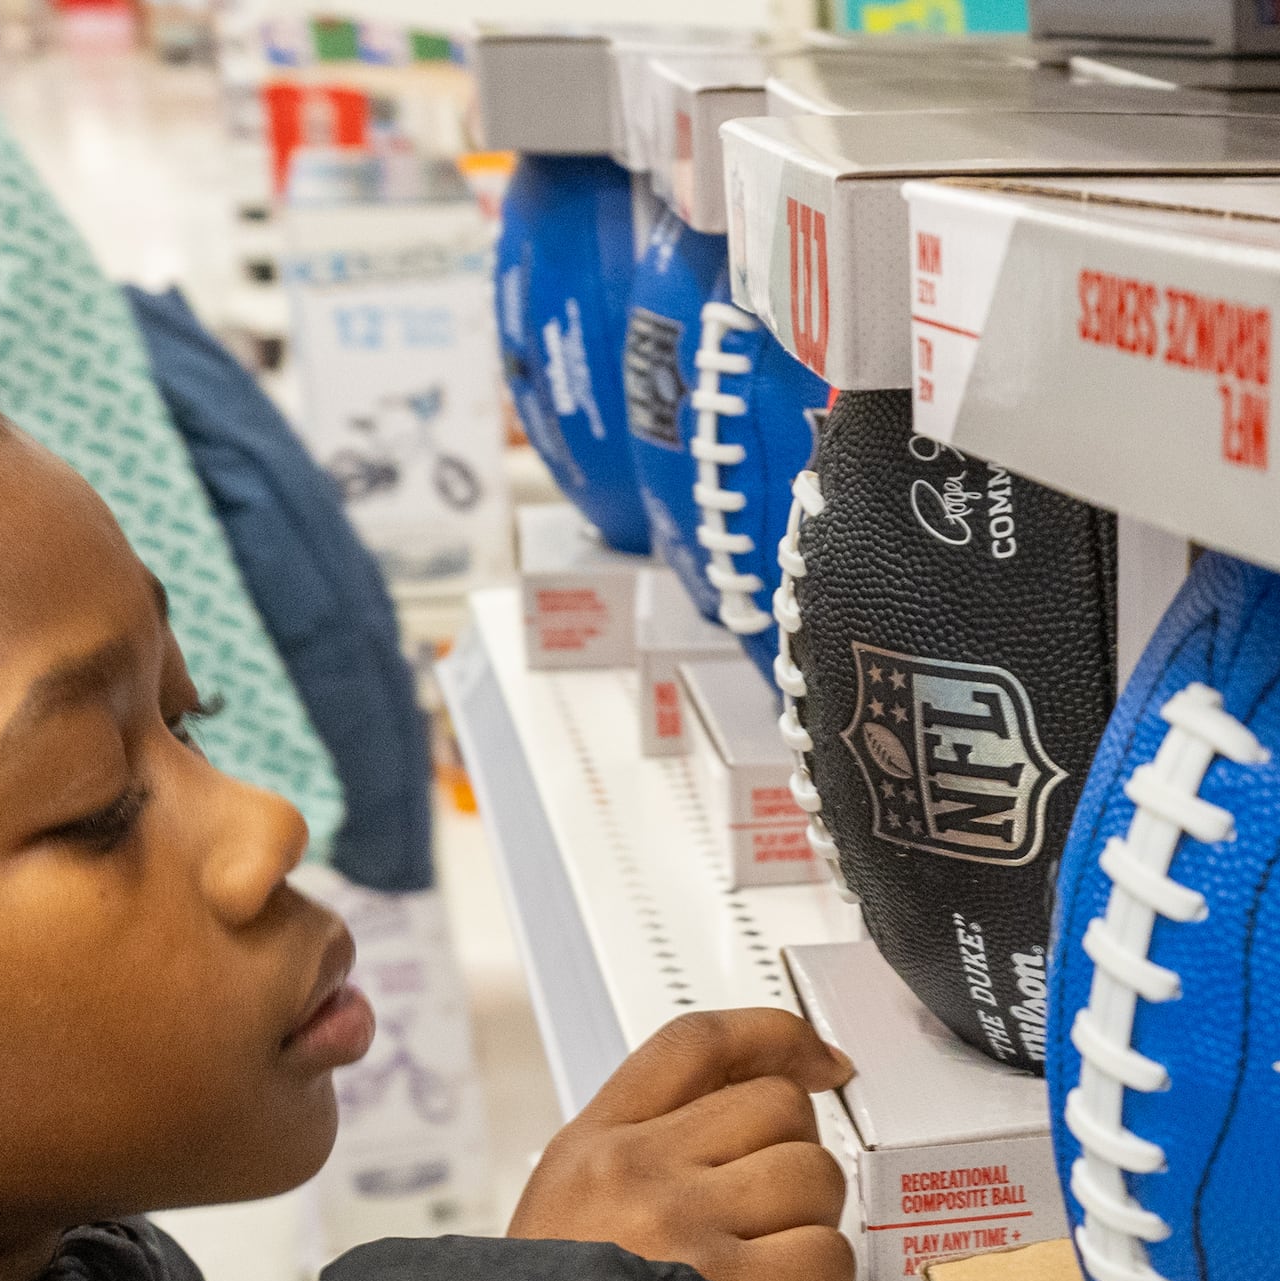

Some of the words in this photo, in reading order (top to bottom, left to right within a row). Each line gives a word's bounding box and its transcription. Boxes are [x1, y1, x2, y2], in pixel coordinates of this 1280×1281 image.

[1078, 268, 1158, 361] SERIES
[1163, 287, 1271, 386] BRONZE
[1221, 382, 1270, 471] NFL
[923, 688, 1024, 849] NFL
[900, 1165, 1010, 1193] RECREATIONAL
[901, 1189, 990, 1214] COMPOSITE
[992, 1185, 1027, 1206] BALL
[903, 1234, 940, 1254] PLAY
[942, 1231, 971, 1251] ANY
[973, 1228, 1009, 1248] TIME
